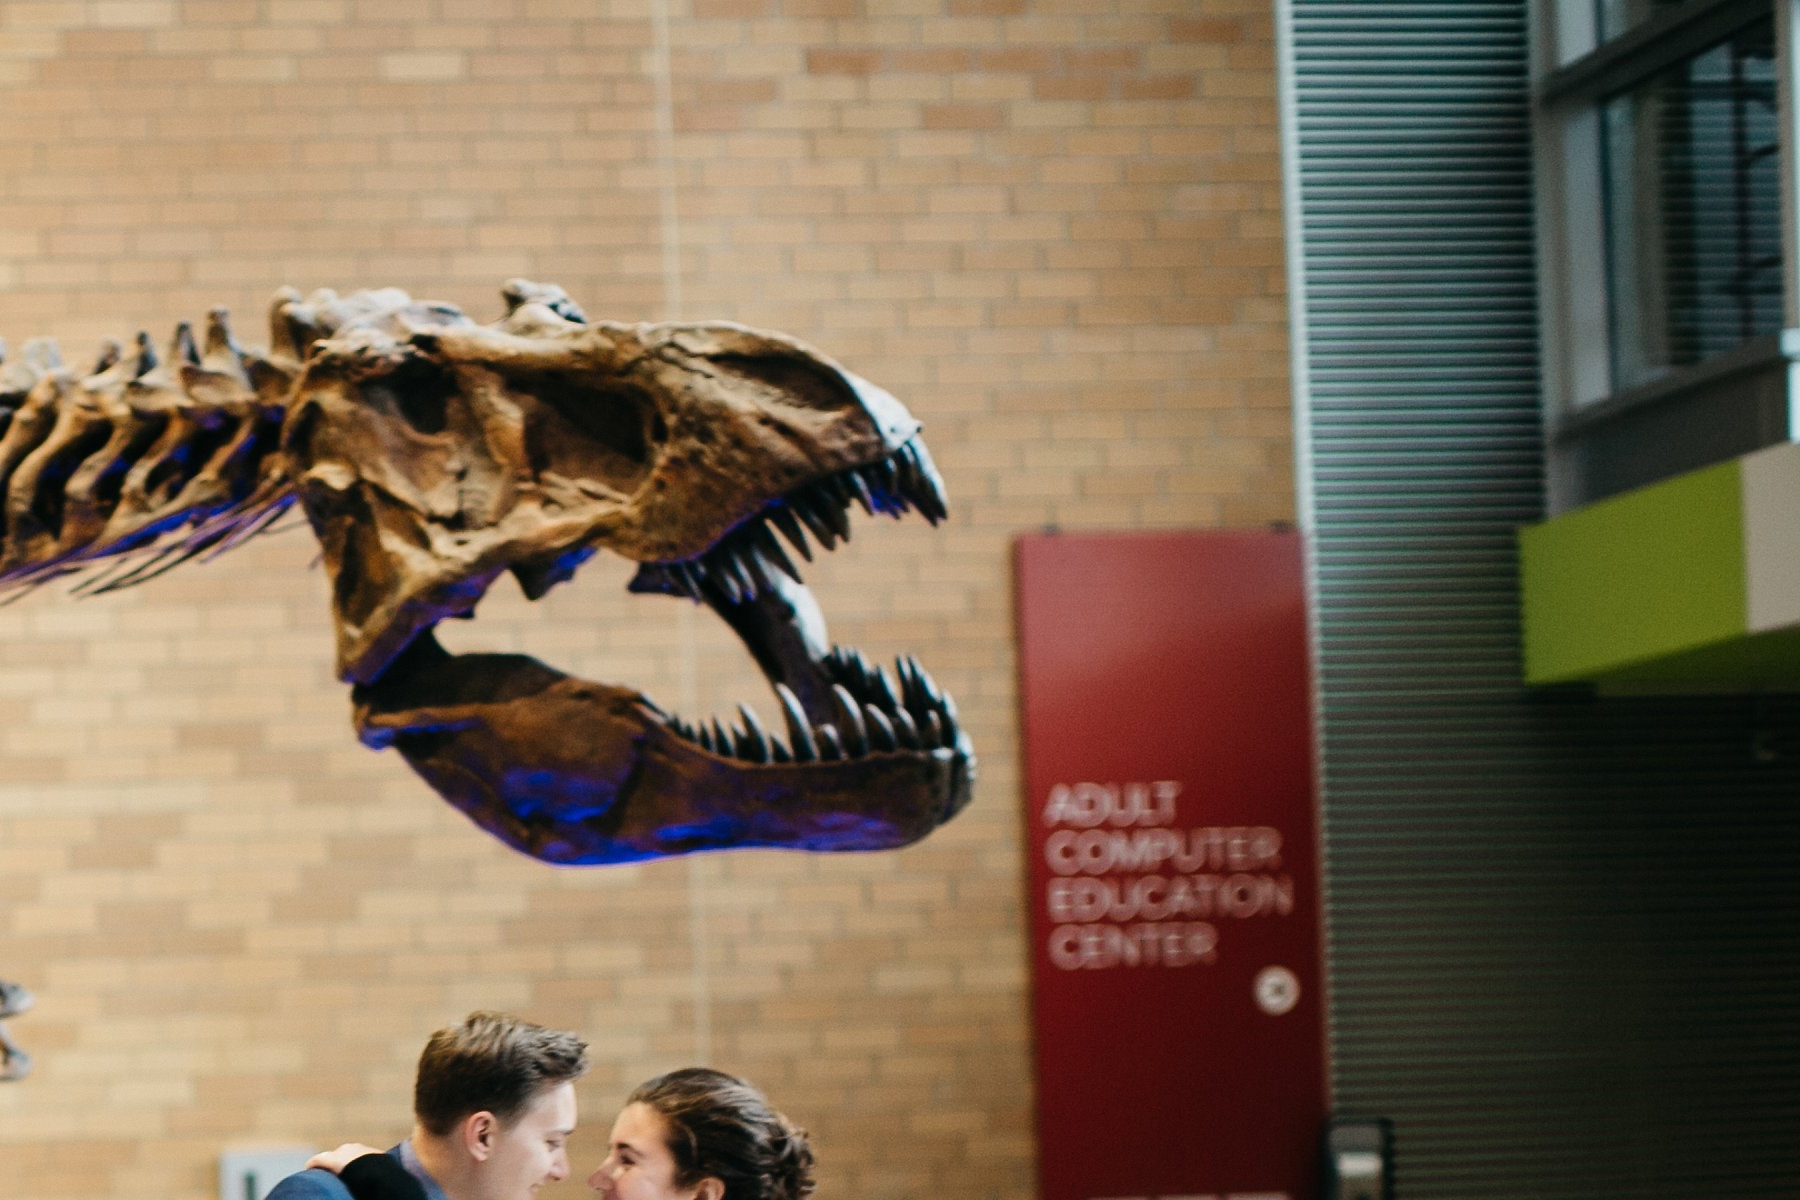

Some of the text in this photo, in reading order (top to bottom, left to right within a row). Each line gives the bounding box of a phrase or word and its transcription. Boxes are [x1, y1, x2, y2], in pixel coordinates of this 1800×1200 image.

[1043, 780, 1181, 828] ADULT
[1045, 826, 1284, 875] COMPUTER
[1047, 873, 1295, 923] EDUCATION
[1048, 921, 1220, 971] CENTER
